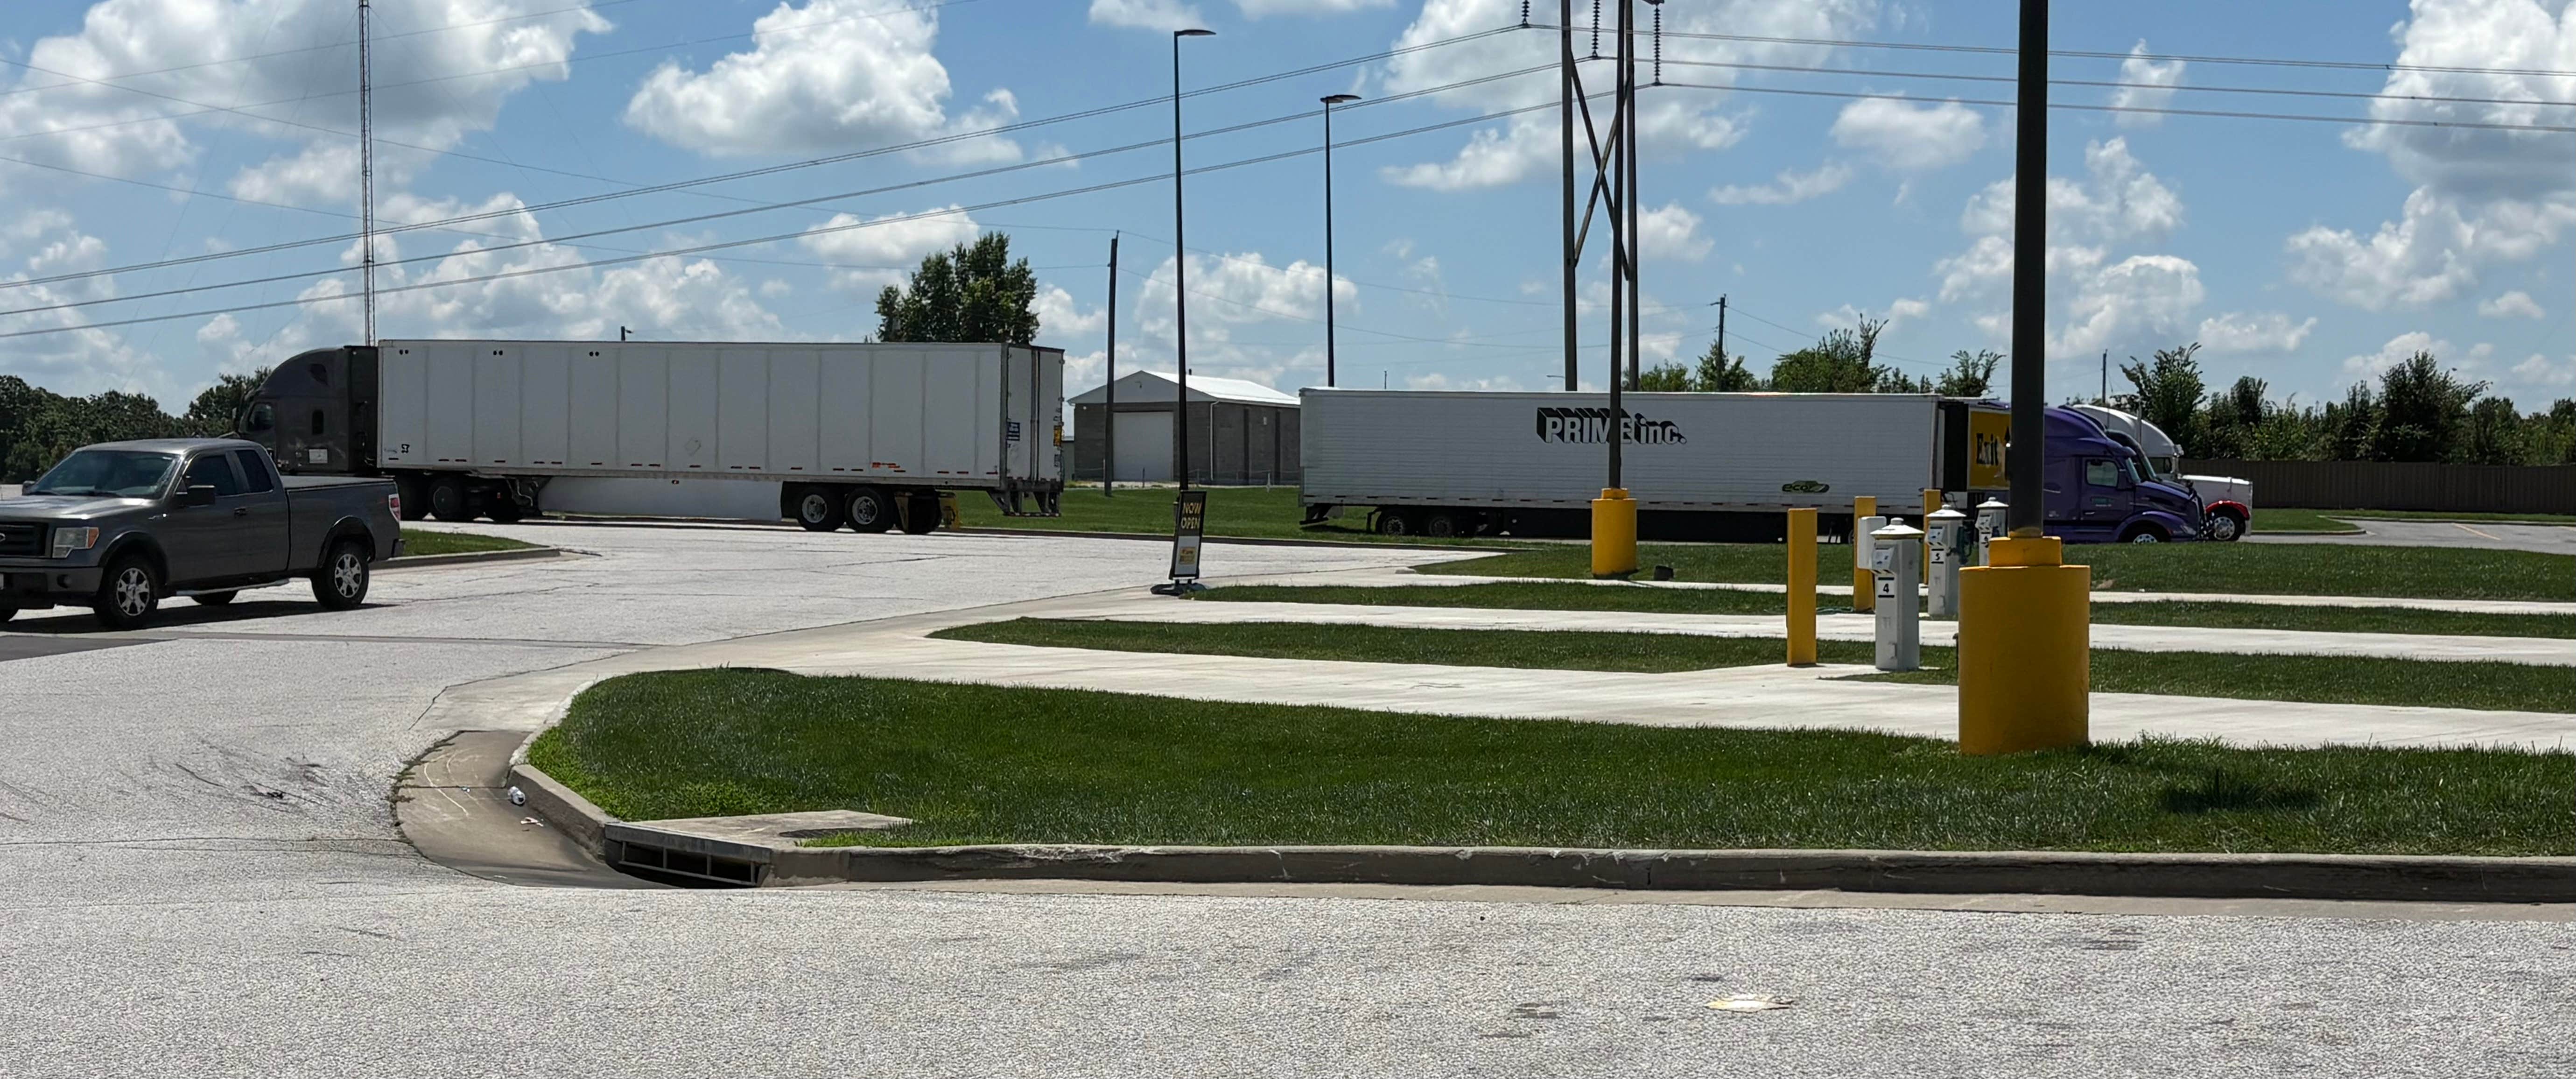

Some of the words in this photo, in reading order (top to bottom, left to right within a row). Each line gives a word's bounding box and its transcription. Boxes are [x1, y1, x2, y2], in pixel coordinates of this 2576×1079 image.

[1537, 408, 1632, 444] PRIME
[1635, 413, 1687, 444] inc.
[1182, 502, 1202, 514] NOW
[1180, 517, 1200, 529] OPEN
[1883, 583, 1889, 593] 4
